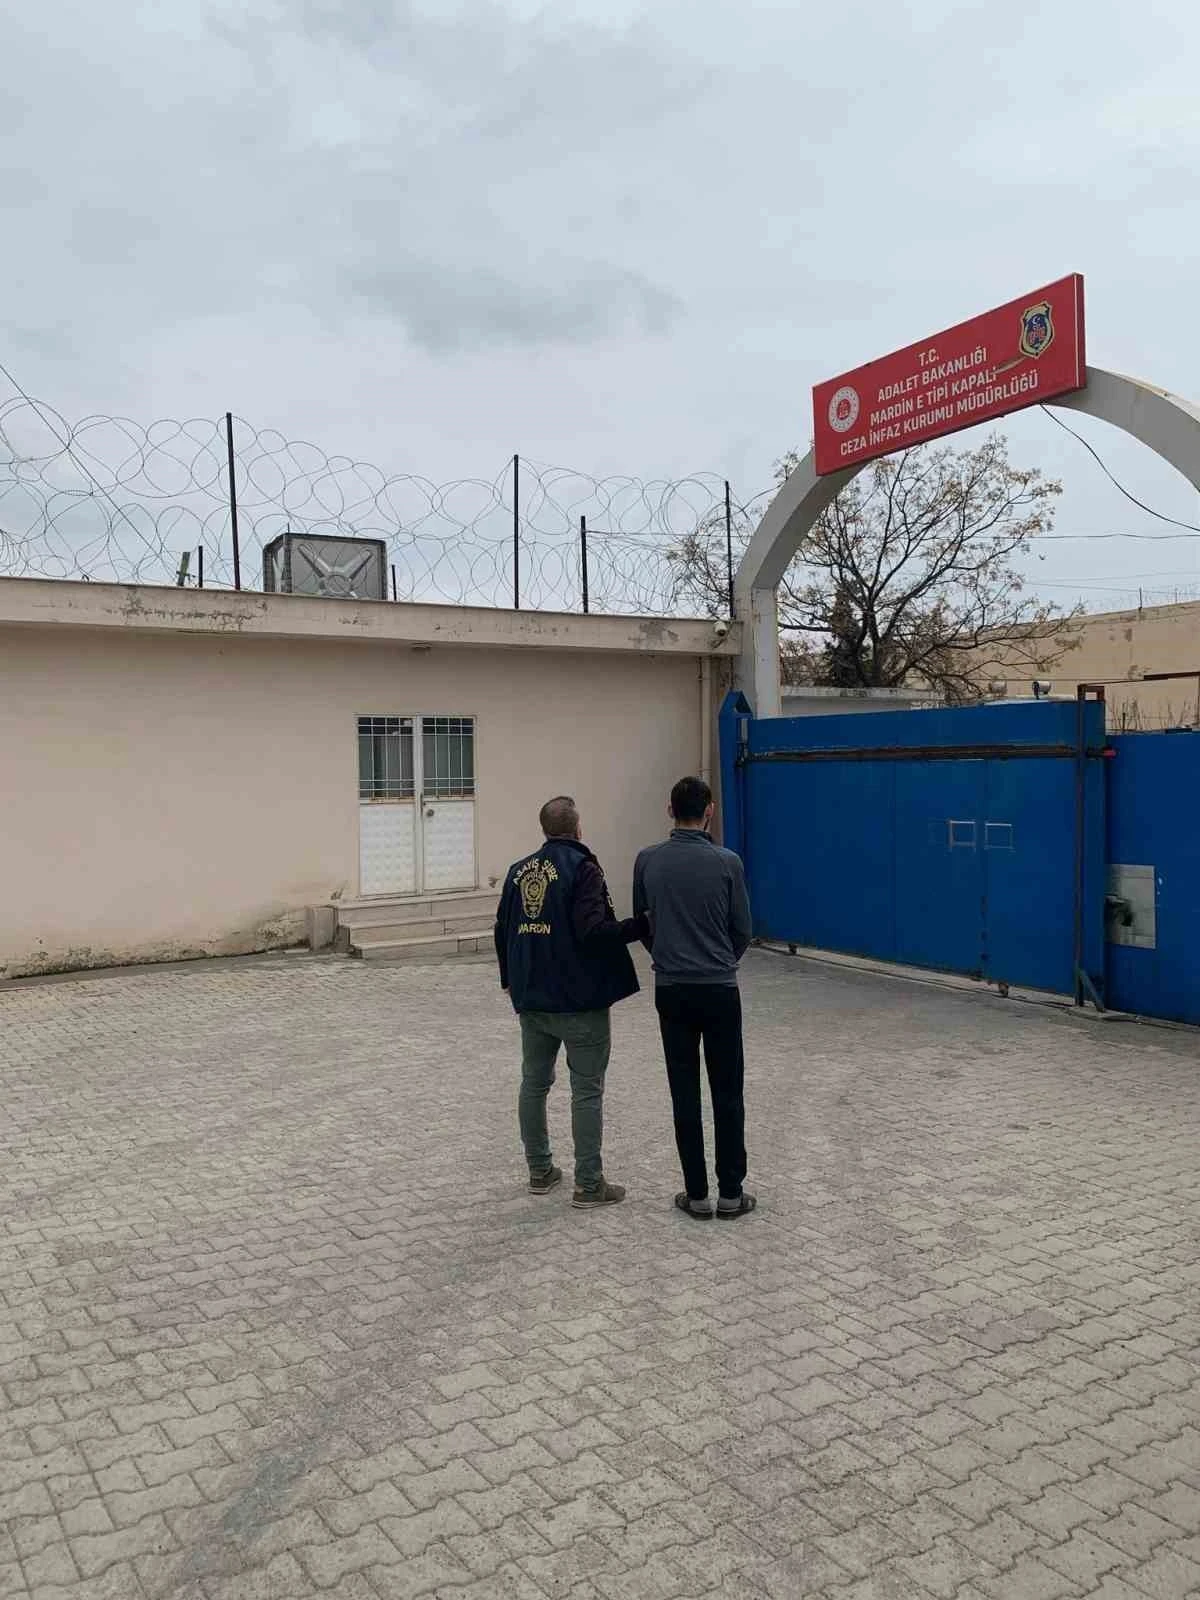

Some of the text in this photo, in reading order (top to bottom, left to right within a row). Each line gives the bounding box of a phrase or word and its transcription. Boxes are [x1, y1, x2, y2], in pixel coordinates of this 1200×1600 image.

[878, 346, 987, 402] ADALET BAKANLIĞI
[919, 349, 940, 366] T.C.
[840, 368, 1039, 456] CEZA İNFAZ KURUMU MÜDÜRLÜĞÜ
[870, 398, 914, 427] MARDİN
[917, 395, 925, 409] E
[926, 381, 949, 406] TİPİ
